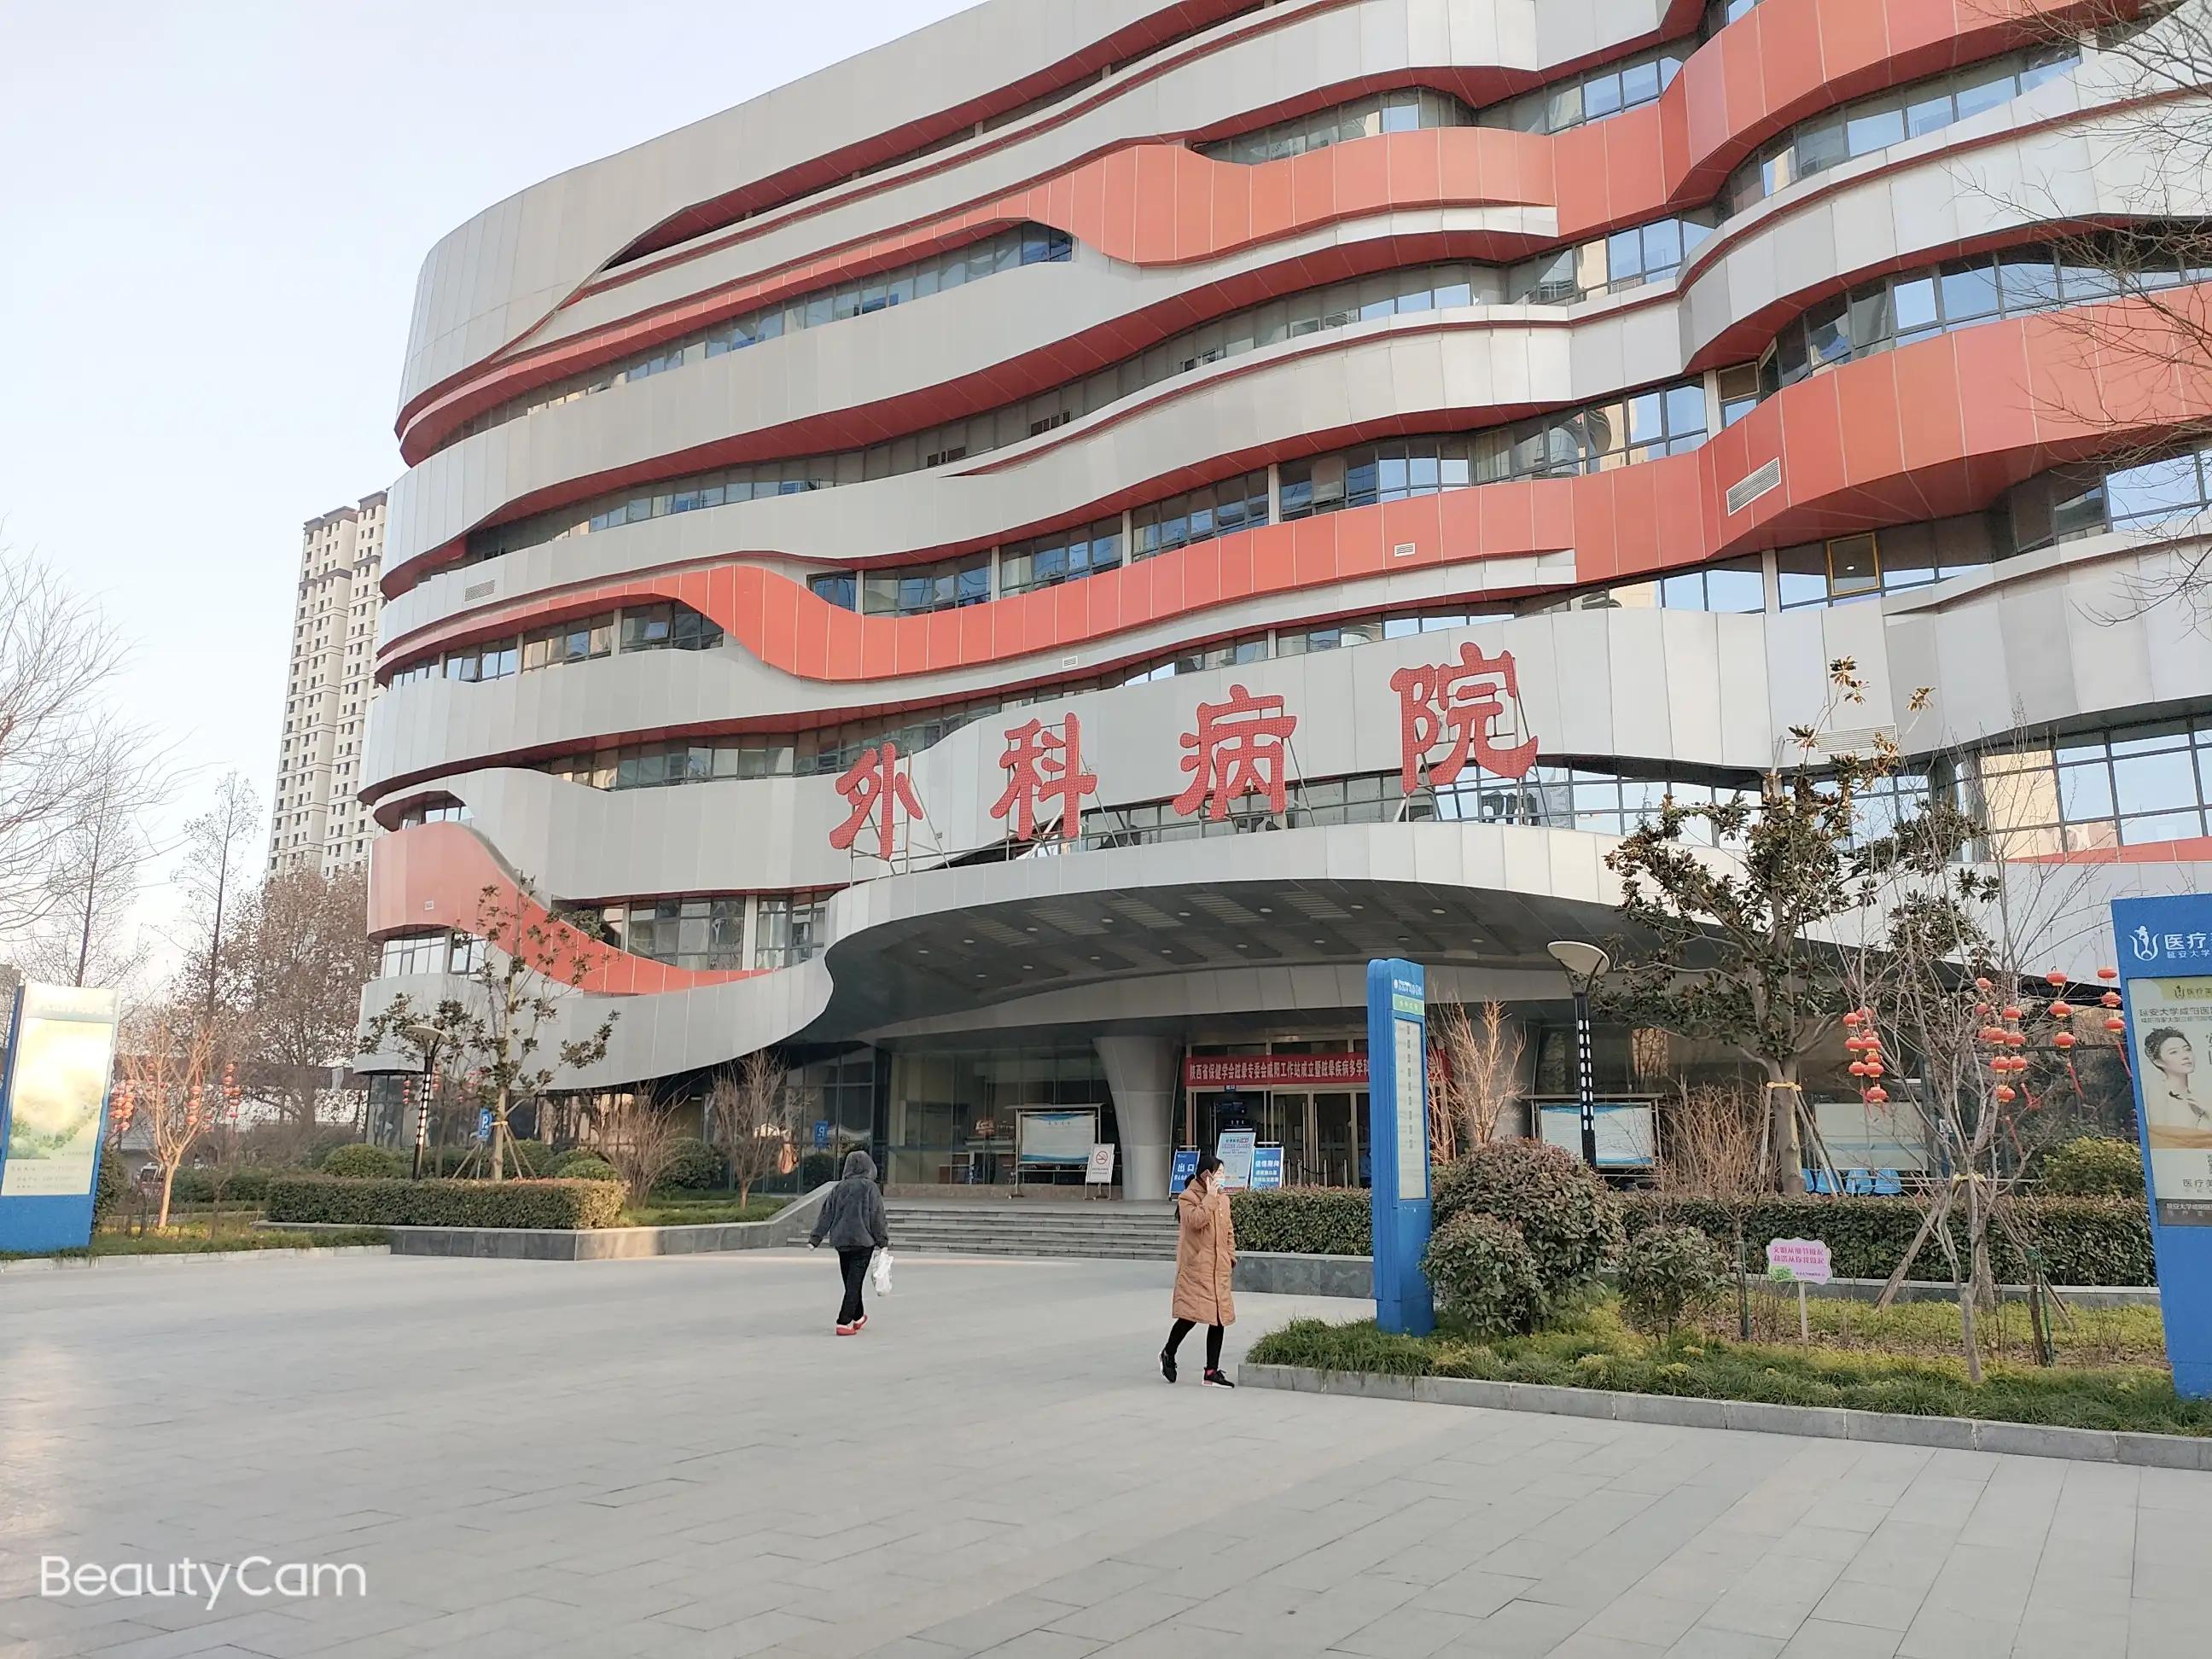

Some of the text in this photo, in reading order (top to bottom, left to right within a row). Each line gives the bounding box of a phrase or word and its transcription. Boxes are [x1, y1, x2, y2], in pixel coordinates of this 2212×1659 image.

[829, 642, 1539, 860] 外科病院
[2164, 932, 2212, 949] 医疗
[2139, 1007, 2212, 1016] 延安大学咸阳医
[1177, 1163, 1195, 1173] 出口
